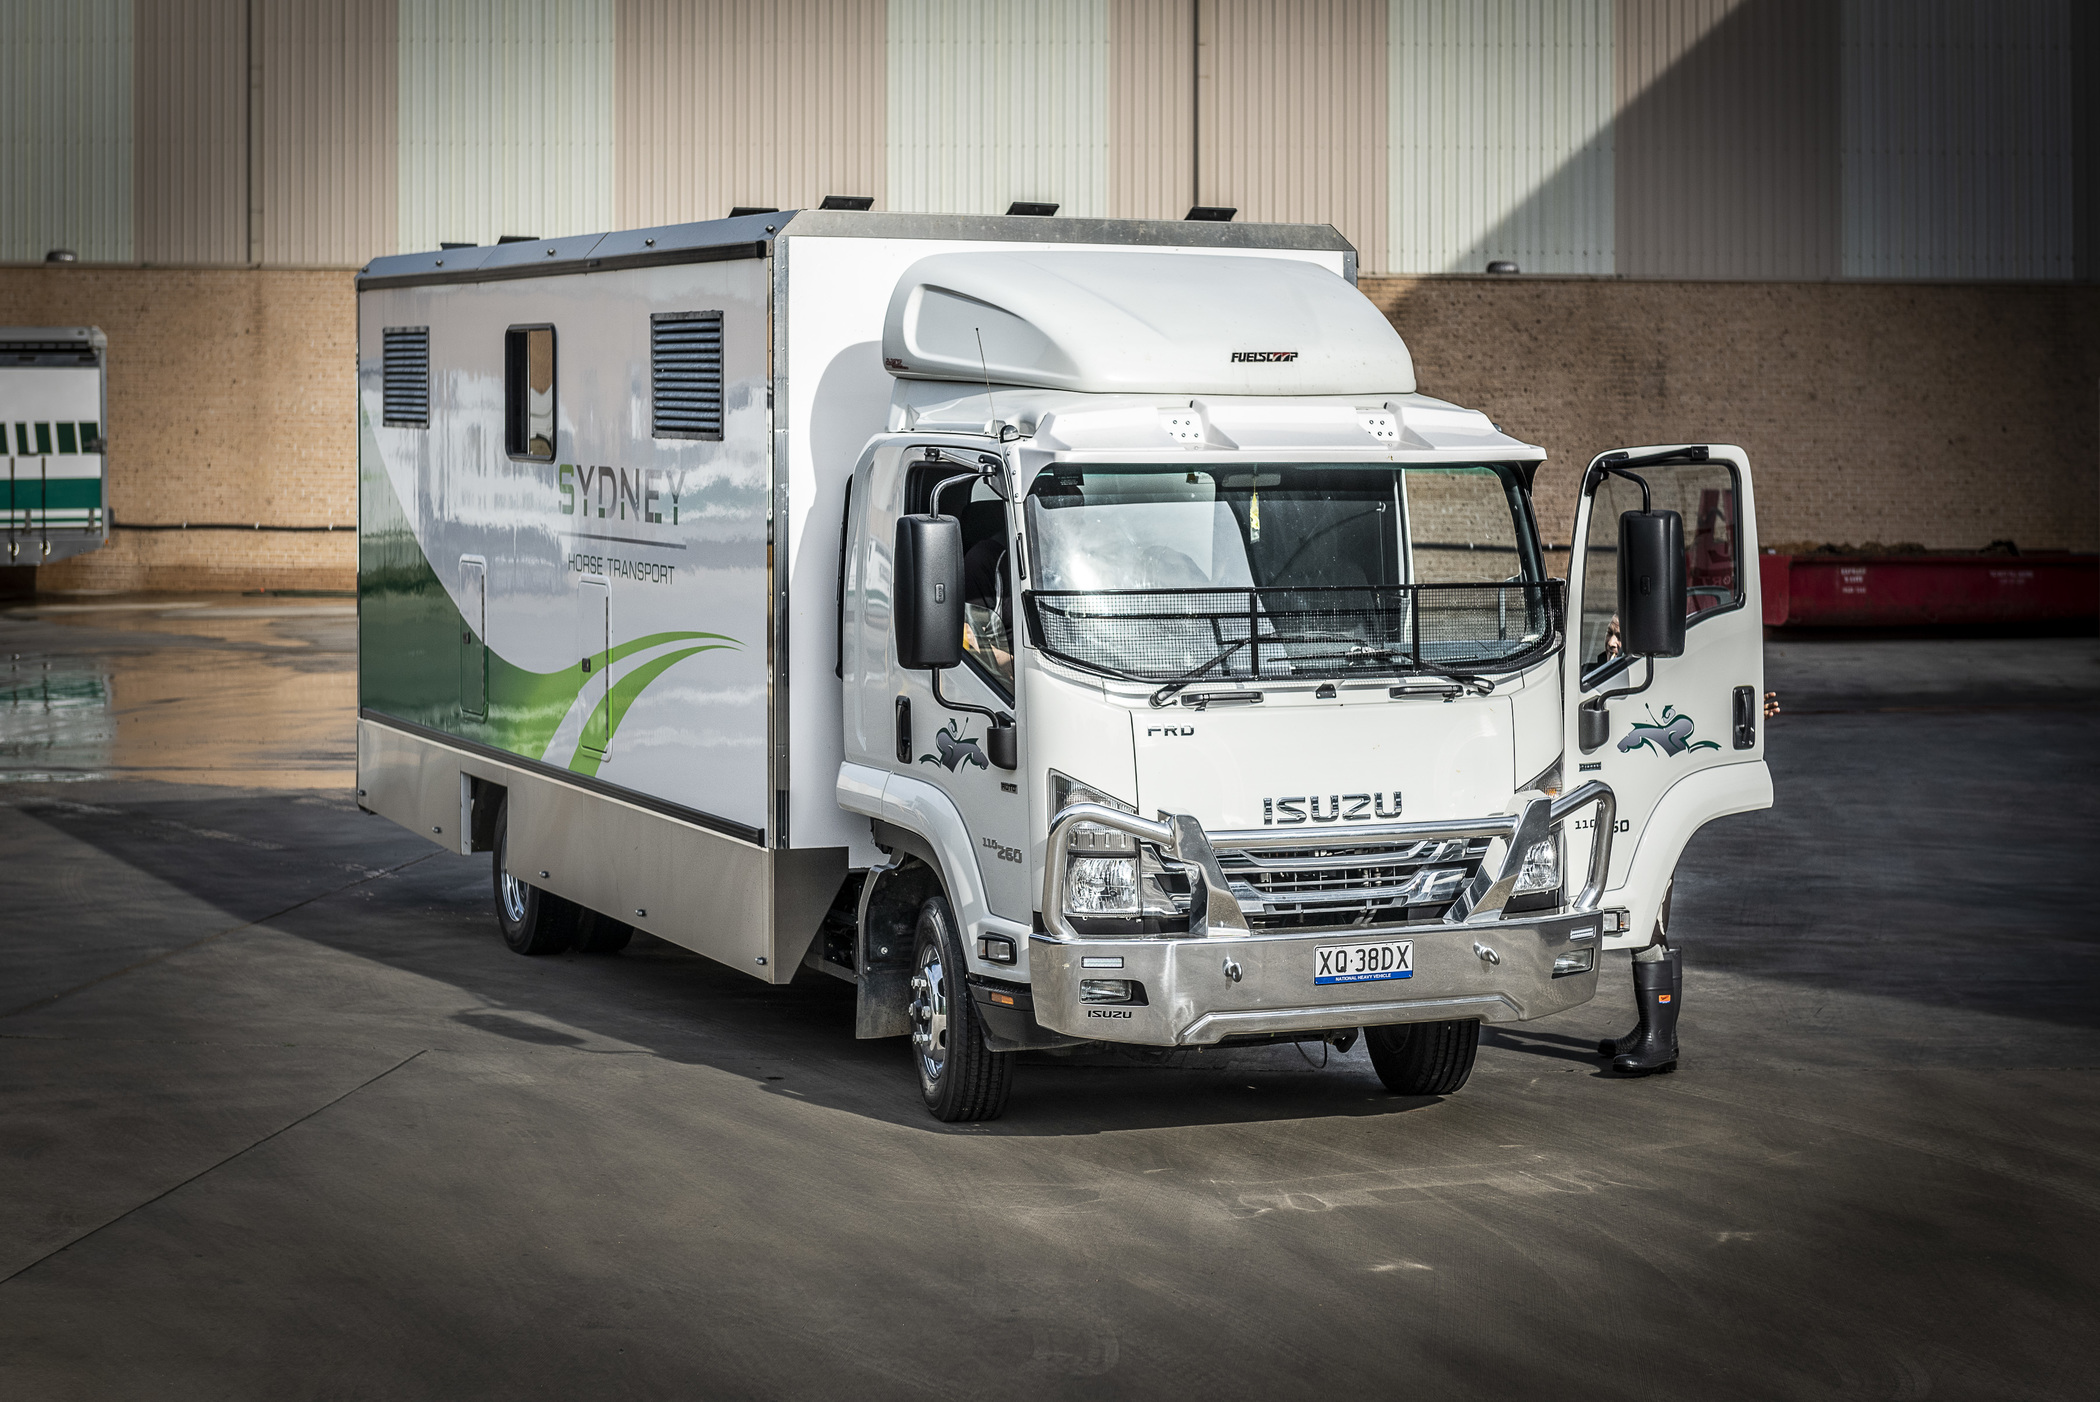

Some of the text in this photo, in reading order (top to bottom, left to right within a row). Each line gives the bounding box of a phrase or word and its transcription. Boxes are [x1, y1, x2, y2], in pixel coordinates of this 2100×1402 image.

[559, 464, 686, 525] SYDNEY
[568, 553, 675, 585] HORSE TRANSPORT
[1148, 723, 1195, 737] FRD
[1263, 791, 1401, 825] ISUZU
[982, 837, 1023, 864] 110 260
[1087, 1010, 1132, 1019] ISUZU
